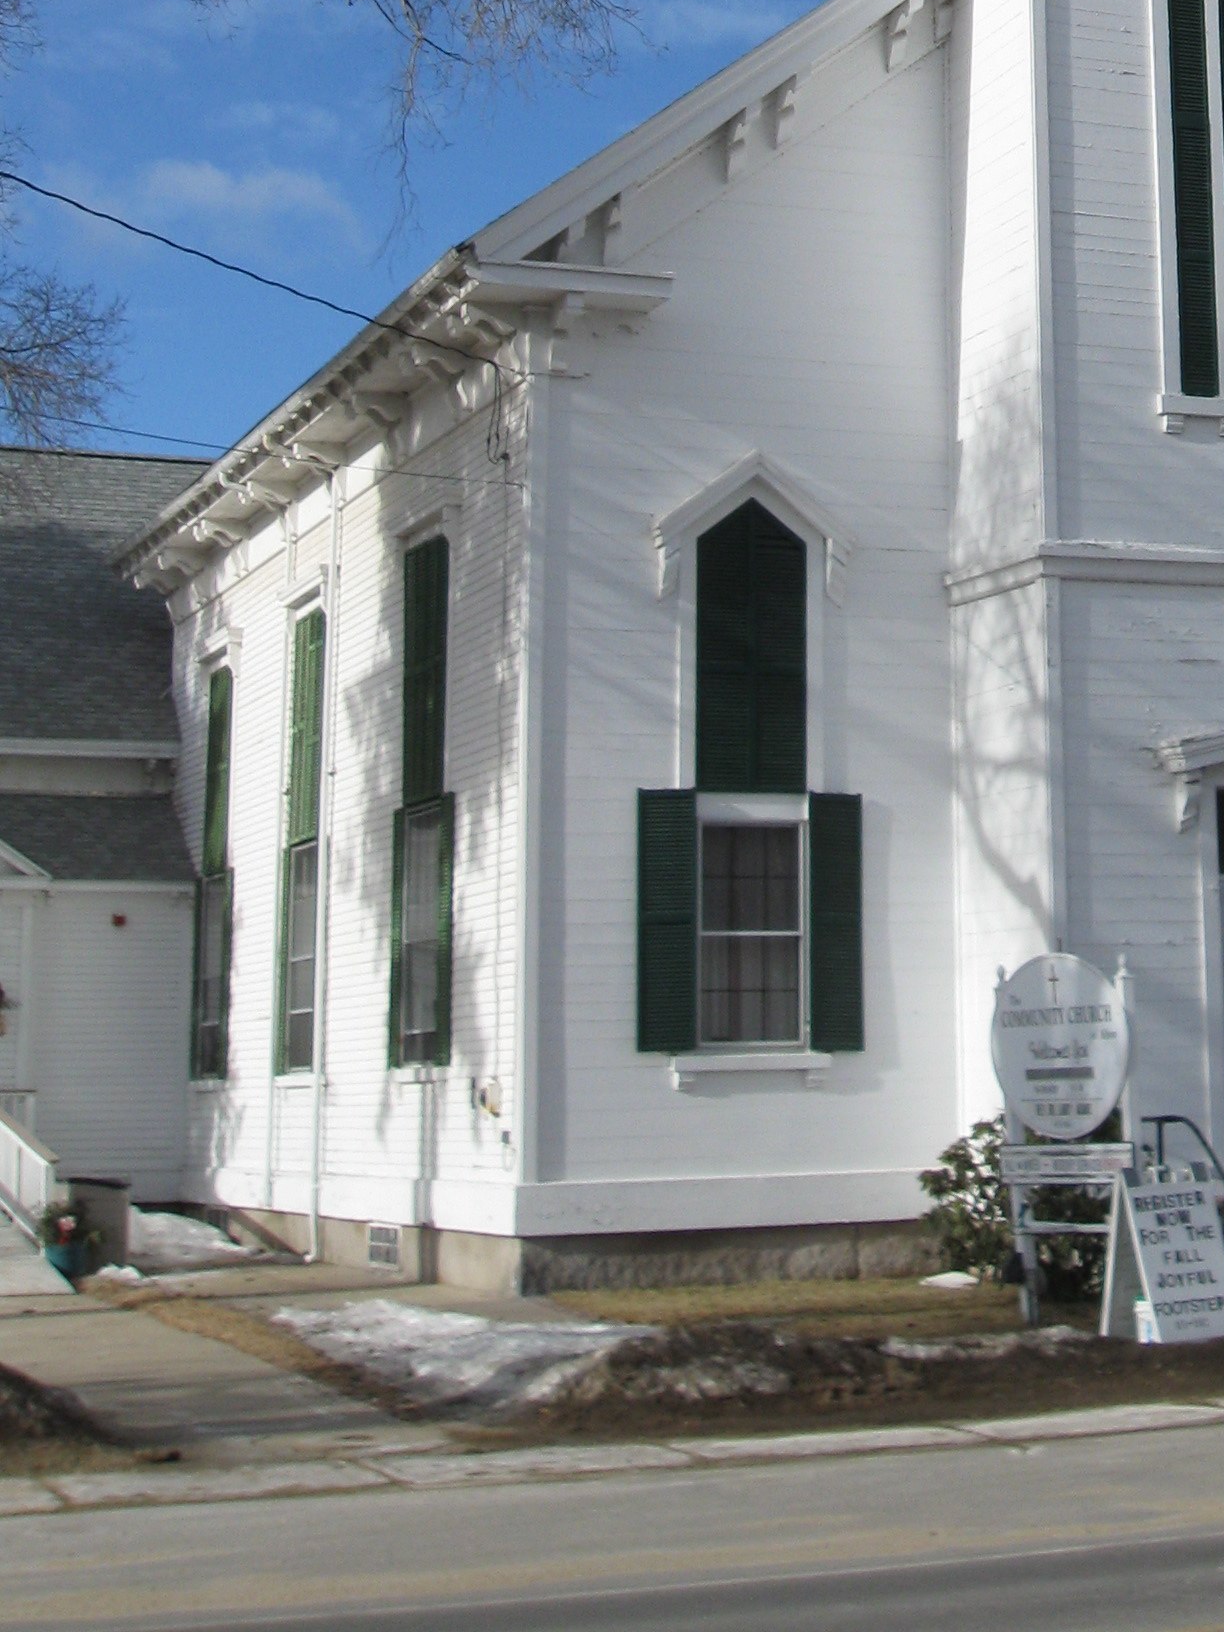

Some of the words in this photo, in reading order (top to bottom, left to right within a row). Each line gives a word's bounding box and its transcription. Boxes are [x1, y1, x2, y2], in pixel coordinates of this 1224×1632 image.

[1002, 1007, 1064, 1028] COMMUNITY
[1068, 1005, 1112, 1023] CHURCH
[1134, 1191, 1206, 1210] REGISTER
[1155, 1210, 1191, 1226] NOW
[1140, 1229, 1171, 1246] FOR
[1184, 1225, 1215, 1241] THE
[1164, 1249, 1205, 1264] FALL
[1157, 1270, 1218, 1288] JOYFUL
